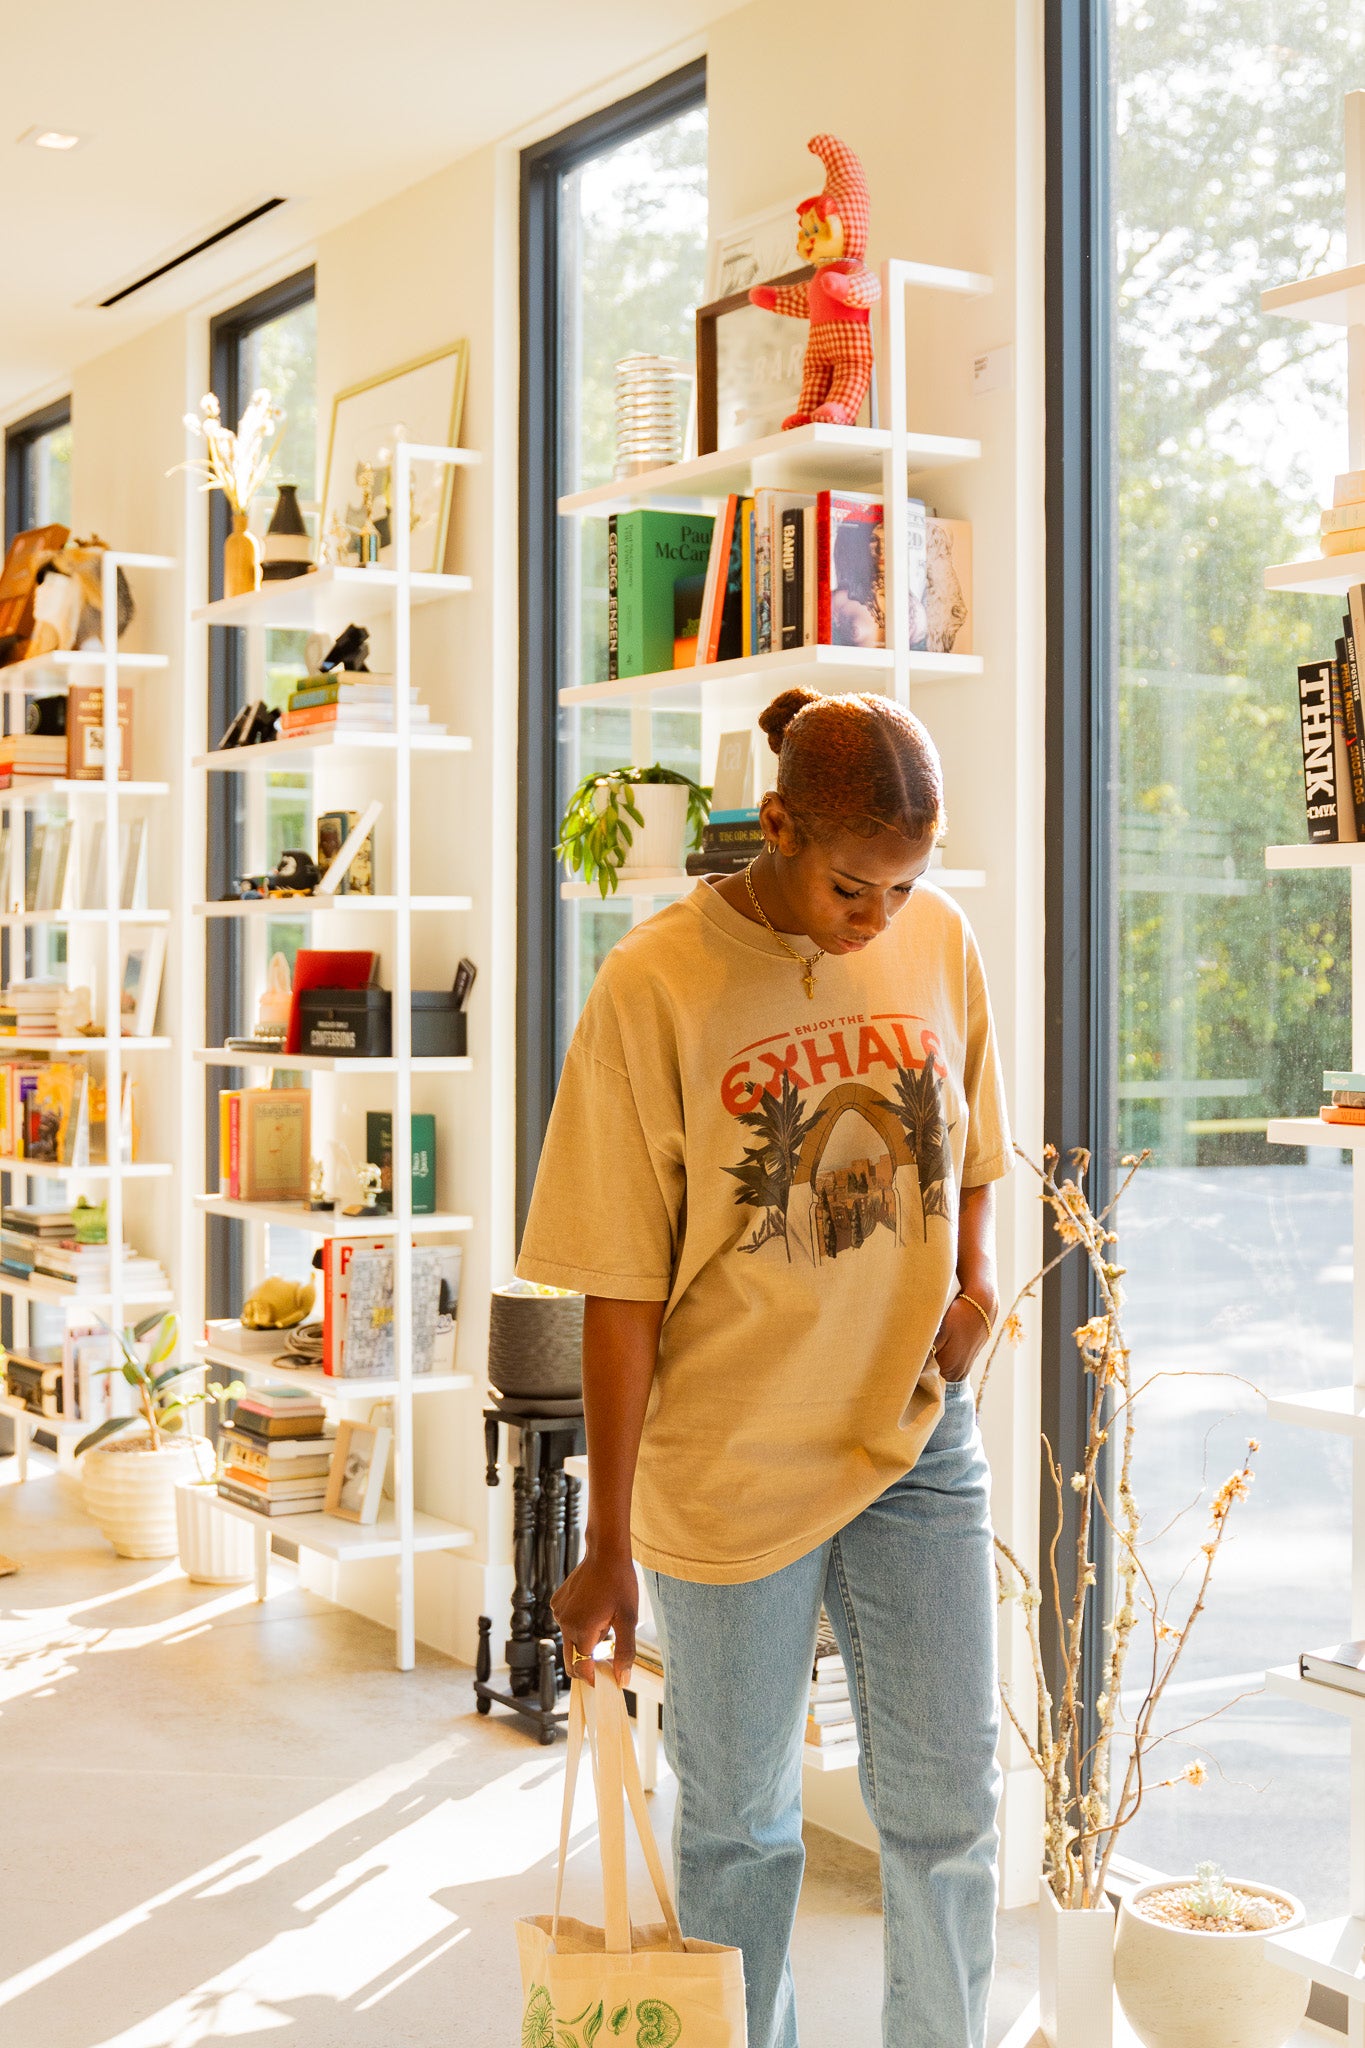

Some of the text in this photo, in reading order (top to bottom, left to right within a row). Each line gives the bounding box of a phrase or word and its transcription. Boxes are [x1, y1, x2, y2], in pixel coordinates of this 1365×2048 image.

[609, 532, 618, 652] GEORG JENSEN
[1347, 636, 1355, 661] SHOW
[1341, 663, 1351, 690] PHIL
[1350, 663, 1361, 702] POSTERS
[1344, 691, 1357, 734] KNIGHT
[1350, 745, 1362, 777] SHOE
[1353, 777, 1365, 805] DOG
[794, 1014, 865, 1036] ENJOY THE
